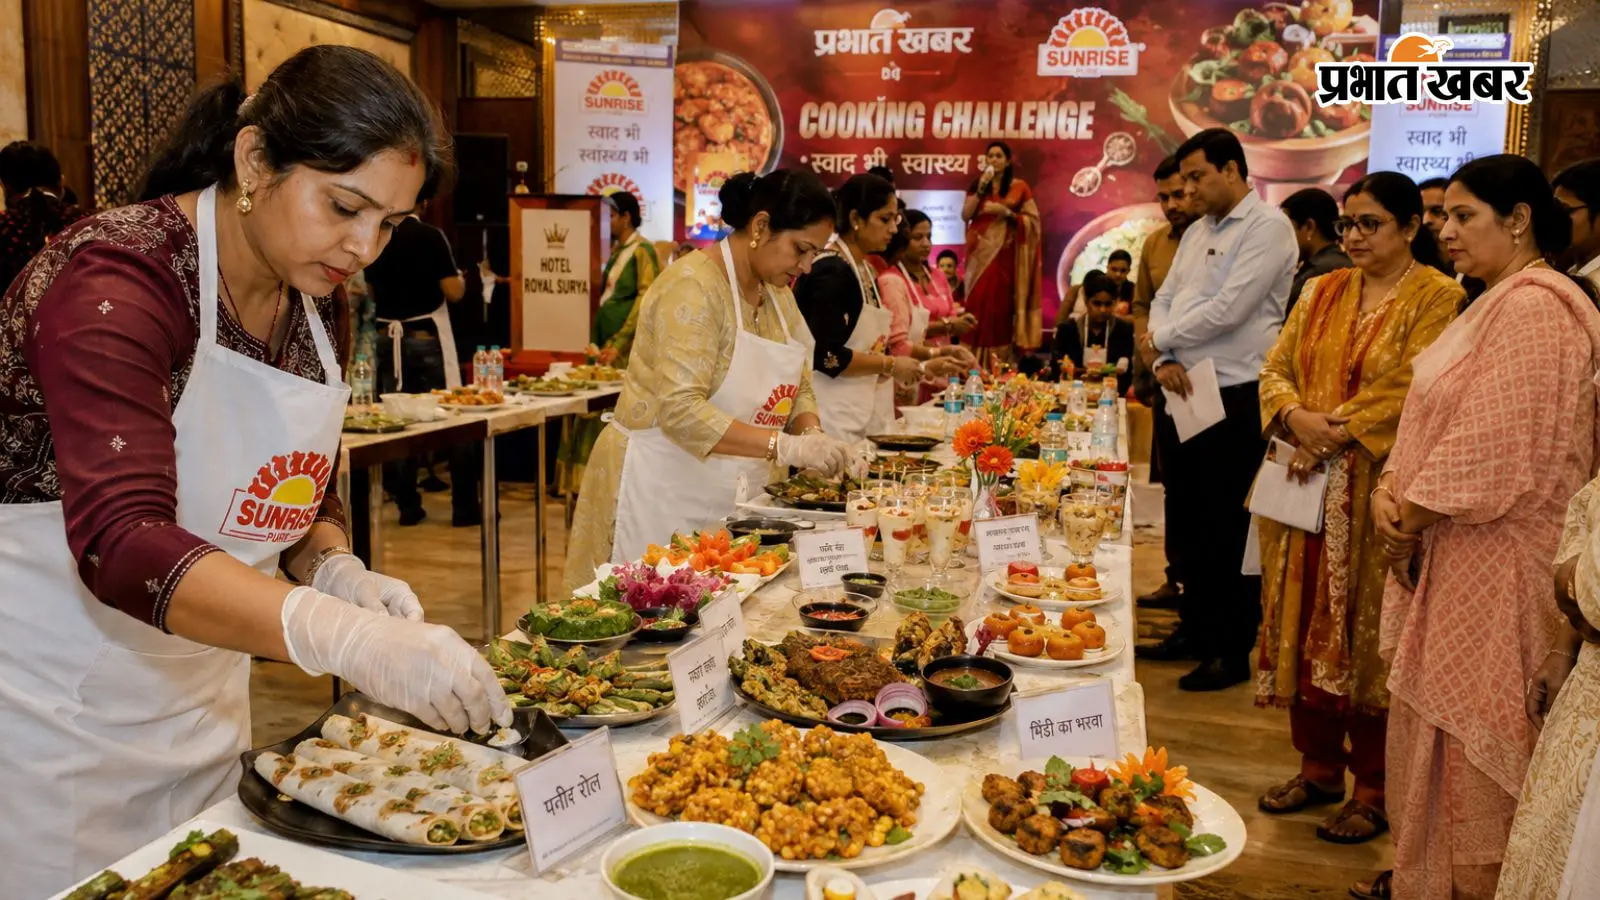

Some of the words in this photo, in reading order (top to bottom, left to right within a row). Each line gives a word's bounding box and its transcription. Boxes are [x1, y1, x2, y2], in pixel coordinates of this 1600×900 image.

[814, 28, 892, 56] प्रभात
[897, 27, 973, 53] खबर
[1047, 50, 1129, 66] SUNRISE
[584, 96, 644, 111] SUNRISE
[799, 100, 925, 138] COOKING
[931, 100, 1096, 139] CHALLENGE
[588, 125, 620, 140] स्वाद
[624, 123, 641, 140] भी
[1407, 130, 1442, 146] स्वाद
[1449, 126, 1467, 146] भी
[811, 153, 857, 174] स्वाद
[901, 153, 971, 174] स्वास्थ्य
[1395, 156, 1451, 172] स्वास्थ्य
[540, 257, 571, 273] HOTEL
[524, 278, 554, 293] ROYAL
[557, 279, 588, 294] SURYA
[1056, 719, 1072, 734] का
[577, 772, 601, 798] रोल
